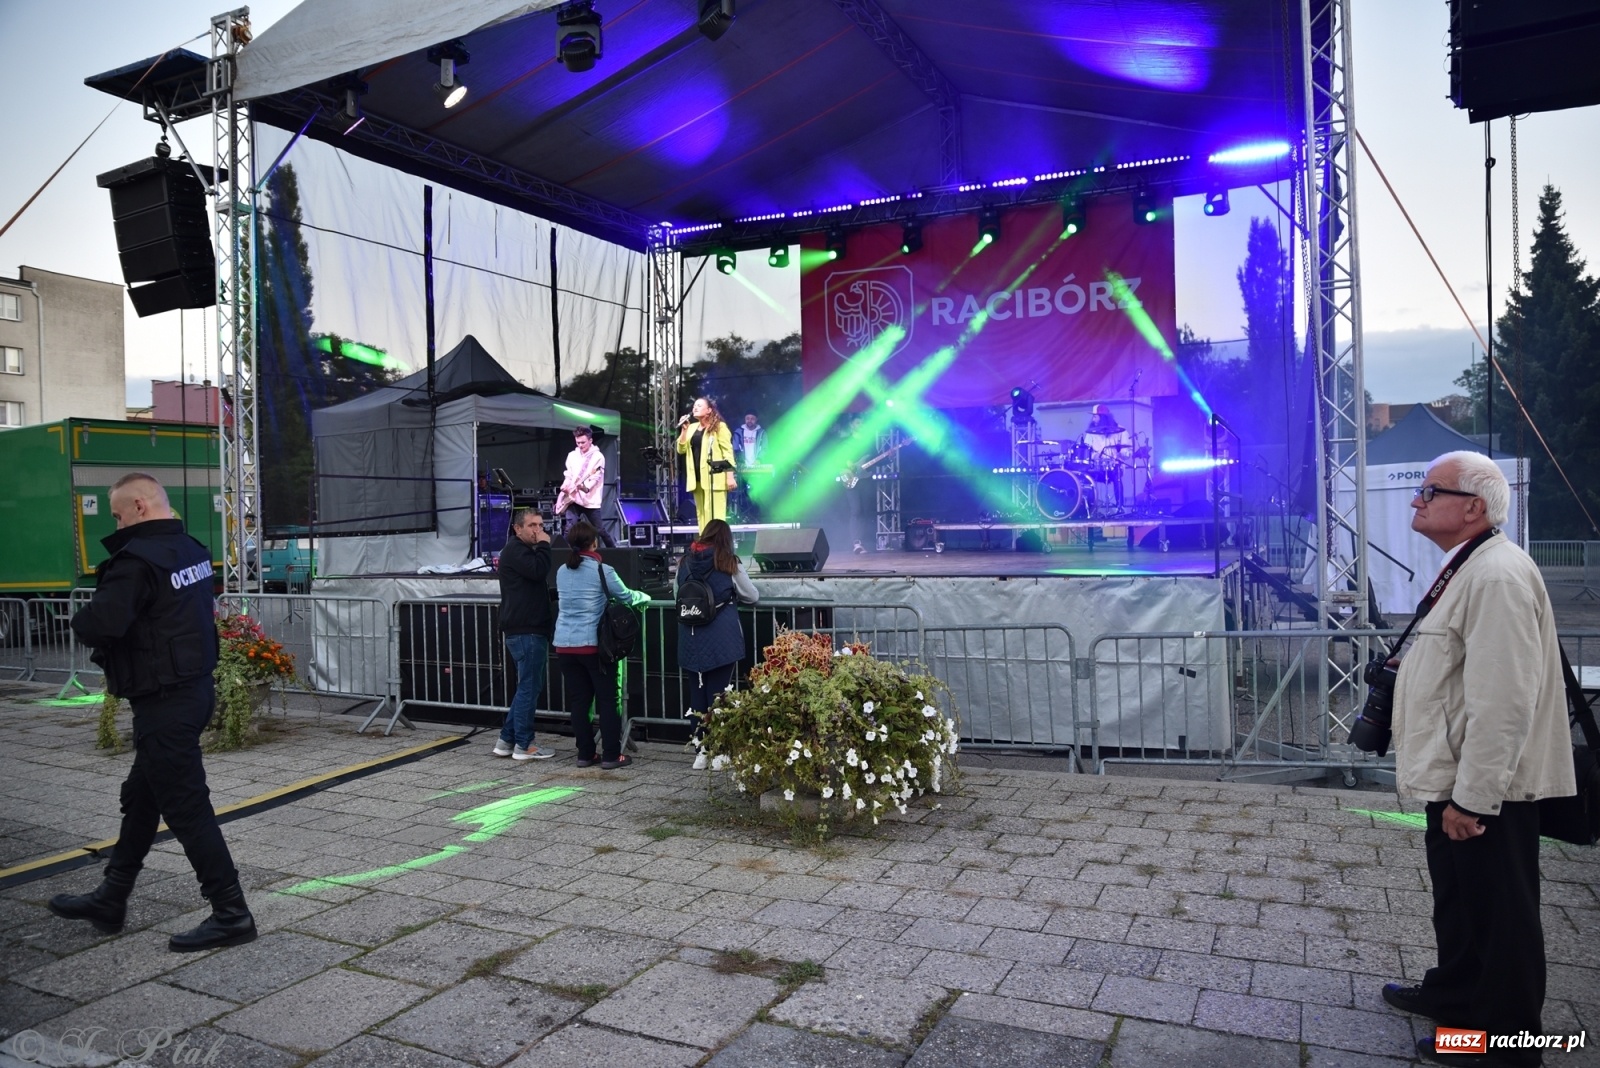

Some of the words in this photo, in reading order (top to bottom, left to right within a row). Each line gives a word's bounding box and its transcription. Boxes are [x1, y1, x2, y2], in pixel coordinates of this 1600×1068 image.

[931, 272, 1144, 326] RACIBÓRZ
[1430, 579, 1445, 598] EOS
[1443, 568, 1453, 580] 6D
[680, 604, 702, 617] Barbie
